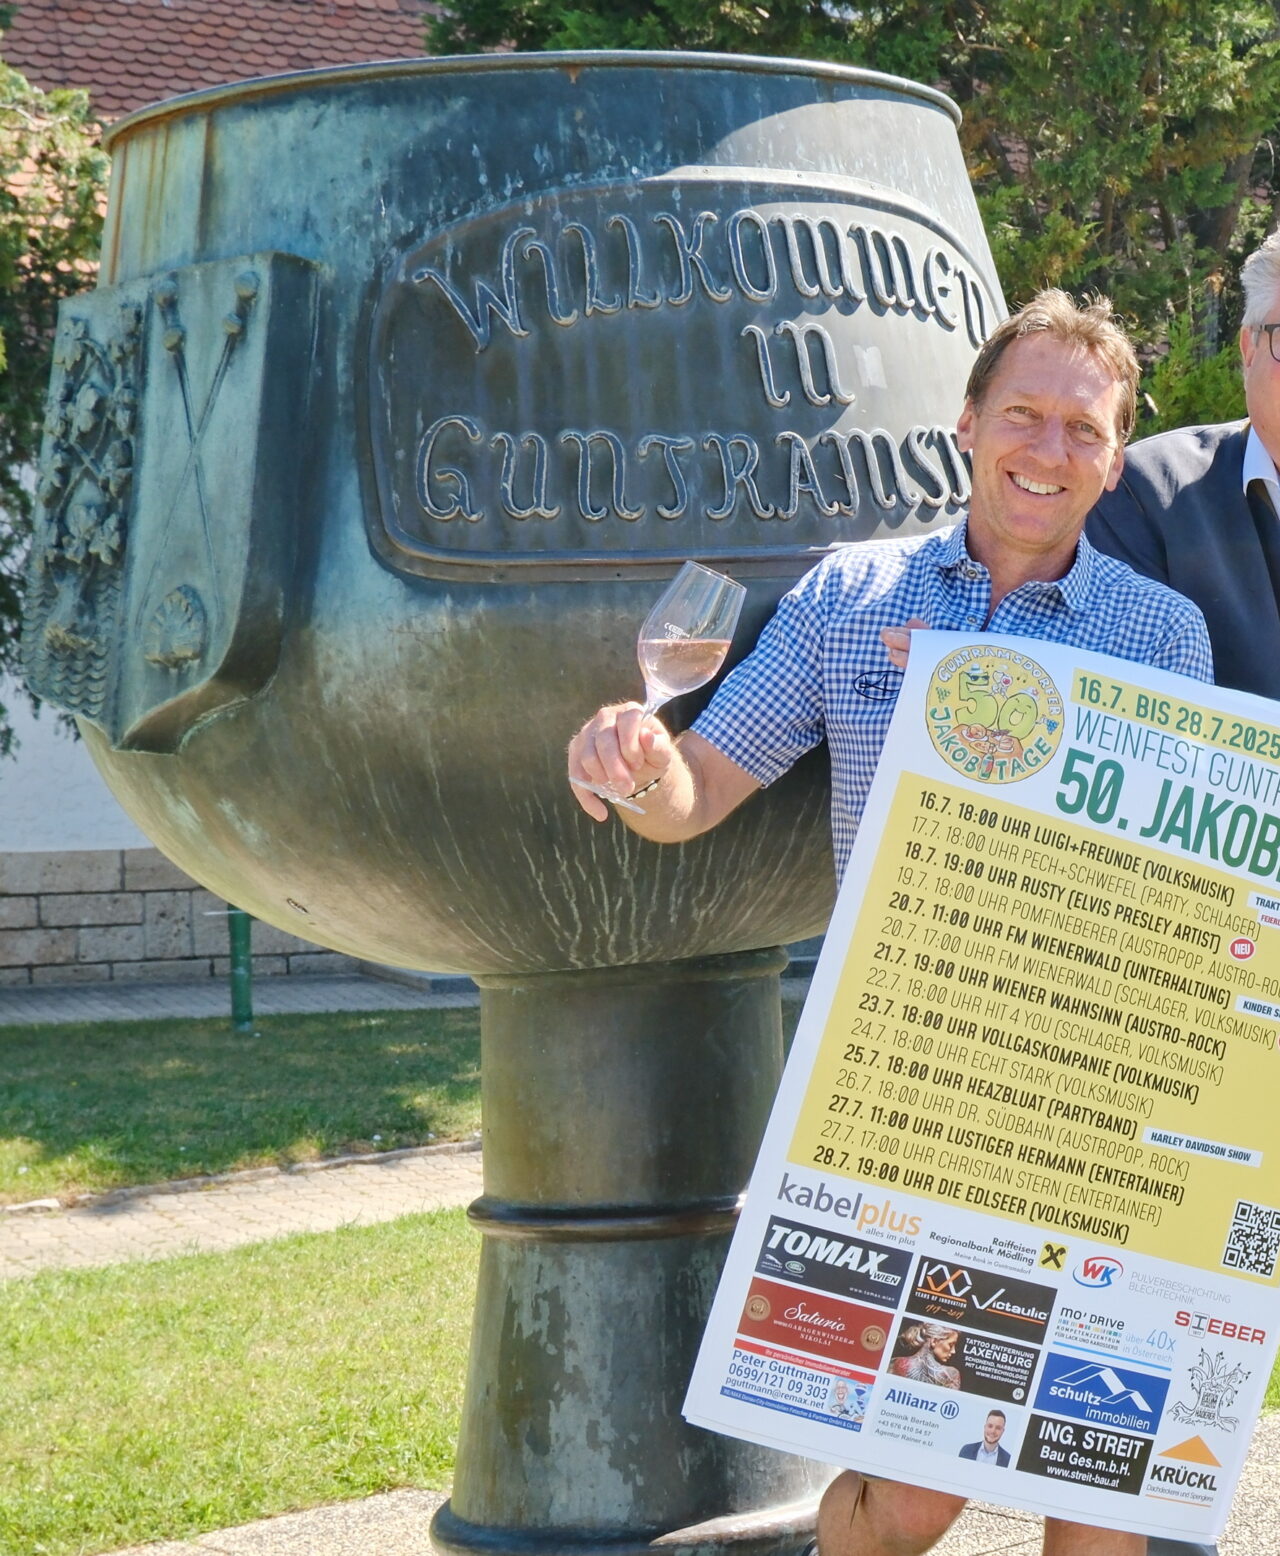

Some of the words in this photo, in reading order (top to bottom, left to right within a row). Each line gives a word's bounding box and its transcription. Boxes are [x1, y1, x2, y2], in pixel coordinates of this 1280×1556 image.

[938, 647, 1062, 715] GUNTRAMSDORFER
[1079, 676, 1126, 713] 16.7.
[1135, 693, 1171, 726] BIS
[1075, 706, 1205, 779] WEINFEST
[1055, 747, 1129, 831] 50.
[920, 790, 952, 816] 16.7.
[958, 802, 999, 829] 18:00
[1000, 815, 1032, 840] UHR
[1033, 825, 1142, 874] LUIGI+FREUNDE
[1142, 859, 1235, 908] (VOLKSMUSIK)
[905, 840, 937, 866] 18.7.
[943, 852, 985, 879] 19:00
[987, 865, 1018, 889] UHR
[1019, 875, 1066, 903] RUSTY
[1066, 889, 1112, 918] (ELVIS
[1113, 903, 1173, 936] PRESLEY
[1172, 922, 1221, 955] ARTIST)
[912, 815, 940, 840] 17.7.
[945, 825, 986, 853] 18:00
[988, 838, 1020, 863] UHR
[1021, 848, 1137, 900] PECH+SCHWEFEL
[1139, 885, 1190, 917] (PARTY,
[1193, 902, 1262, 942] SCHLAGER)
[897, 865, 928, 891] 19.7.
[934, 876, 975, 904] 18:00
[977, 889, 1009, 914] UHR
[1010, 899, 1118, 947] POMFINEBERER
[1119, 931, 1204, 975] (AUSTROPOP,
[888, 891, 925, 917] 20.7.
[932, 903, 970, 929] 11:00
[972, 915, 1004, 939] UHR
[1005, 925, 1028, 946] FM
[1031, 931, 1122, 973] WIENERWALD
[1122, 959, 1231, 1010] (UNTERHALTUNG)
[1234, 939, 1251, 958] NEU
[873, 941, 907, 967] 21.7.
[913, 952, 956, 980] 19:00
[958, 965, 989, 989] UHR
[992, 974, 1047, 1006] WIENER
[1049, 991, 1123, 1027] WAHNSINN
[1124, 1013, 1227, 1061] (AUSTRO-ROCK)
[880, 916, 917, 942] 20.7.
[923, 928, 962, 954] 17:00
[964, 939, 996, 964] UHR
[997, 949, 1020, 971] FM
[1022, 956, 1113, 998] WIENERWALD
[1113, 982, 1189, 1023] (SCHLAGER,
[1195, 1007, 1277, 1050] VOLKSMUSIK)
[865, 966, 901, 993] 22.7.
[907, 978, 948, 1005] 18:00
[950, 990, 983, 1015] UHR
[984, 999, 1008, 1021] HIT
[1008, 1008, 1020, 1025] 4
[1024, 1010, 1053, 1034] YOU
[1053, 1019, 1133, 1059] (SCHLAGER,
[1138, 1042, 1225, 1087] VOLKSMUSIK)
[1242, 1000, 1273, 1016] KINDER
[857, 992, 895, 1018] 23.7.
[902, 1004, 944, 1031] 18:00
[946, 1016, 978, 1040] UHR
[981, 1025, 1112, 1077] VOLLGASKOMPANIE
[1112, 1063, 1200, 1105] (VOLKMUSIK)
[850, 1017, 887, 1043] 24.7.
[892, 1029, 934, 1056] 18:00
[936, 1041, 969, 1065] UHR
[970, 1050, 1008, 1075] ECHT
[1008, 1060, 1055, 1089] STARK
[1055, 1073, 1155, 1119] (VOLKSMUSIK)
[843, 1043, 880, 1069] 25.7.
[887, 1055, 930, 1081] 18:00
[932, 1066, 964, 1091] UHR
[966, 1076, 1046, 1113] HEAZBLUAT
[1046, 1098, 1138, 1141] (PARTYBAND)
[835, 1068, 872, 1094] 26.7.
[878, 1080, 920, 1106] 18:00
[921, 1091, 955, 1116] UHR
[956, 1100, 980, 1123] DR.
[985, 1106, 1055, 1143] SÜDBAHN
[1056, 1127, 1144, 1168] (AUSTROPOP,
[1148, 1152, 1190, 1182] ROCK)
[828, 1093, 863, 1119] 27.7.
[870, 1105, 910, 1131] 11:00
[912, 1116, 944, 1140] UHR
[946, 1125, 1014, 1158] LUSTIGER
[1016, 1143, 1086, 1177] HERMANN
[1088, 1162, 1185, 1207] (ENTERTAINER)
[1150, 1131, 1184, 1147] HARLEY
[1184, 1139, 1226, 1157] DAVIDSON
[1226, 1148, 1251, 1162] SHOW
[819, 1119, 855, 1145] 27.7.
[860, 1130, 900, 1156] 17:00
[902, 1141, 936, 1165] UHR
[937, 1150, 1014, 1186] CHRISTIAN
[1015, 1170, 1062, 1198] STERN
[1062, 1182, 1163, 1227] (ENTERTAINER)
[812, 1144, 850, 1171] 28.7.
[857, 1157, 900, 1183] 19:00
[902, 1168, 935, 1192] UHR
[936, 1177, 964, 1200] DIE
[965, 1185, 1028, 1216] EDLSEER
[1029, 1201, 1130, 1245] (VOLKSMUSIK)
[766, 1224, 889, 1278] TOMAX
[929, 1231, 995, 1255] Regionalbank
[996, 1248, 1035, 1266] Mödling
[991, 1237, 1037, 1255] Raiffeisen
[873, 1272, 899, 1284] WIEN
[1082, 1259, 1117, 1285] WK
[1130, 1271, 1232, 1304] PULVERBESCHICHTUNG
[1128, 1281, 1195, 1306] BLECHTECHNIK
[783, 1302, 846, 1332] Saturio
[1174, 1310, 1266, 1345] SIEBER
[962, 1343, 1033, 1369] LAXENBURG
[965, 1337, 991, 1349] TATTOO
[990, 1343, 1035, 1359] ENTFERNUNG
[728, 1362, 784, 1388] 0699/121
[786, 1378, 803, 1394] 09
[804, 1383, 829, 1400] 303
[731, 1349, 766, 1369] Peter
[768, 1360, 832, 1386] Guttmann
[723, 1377, 826, 1410] pguttmann@remax.net
[884, 1388, 938, 1412] Allianz
[1048, 1385, 1102, 1406] schultz
[1084, 1405, 1151, 1431] immobilien
[1038, 1420, 1077, 1447] ING.
[1081, 1430, 1145, 1460] STREIT
[1039, 1444, 1066, 1462] Bau
[1068, 1451, 1131, 1477] Ges.m.b.H.
[1046, 1465, 1120, 1488] www.streit-bau.at
[1150, 1464, 1218, 1492] KRÜCKL
